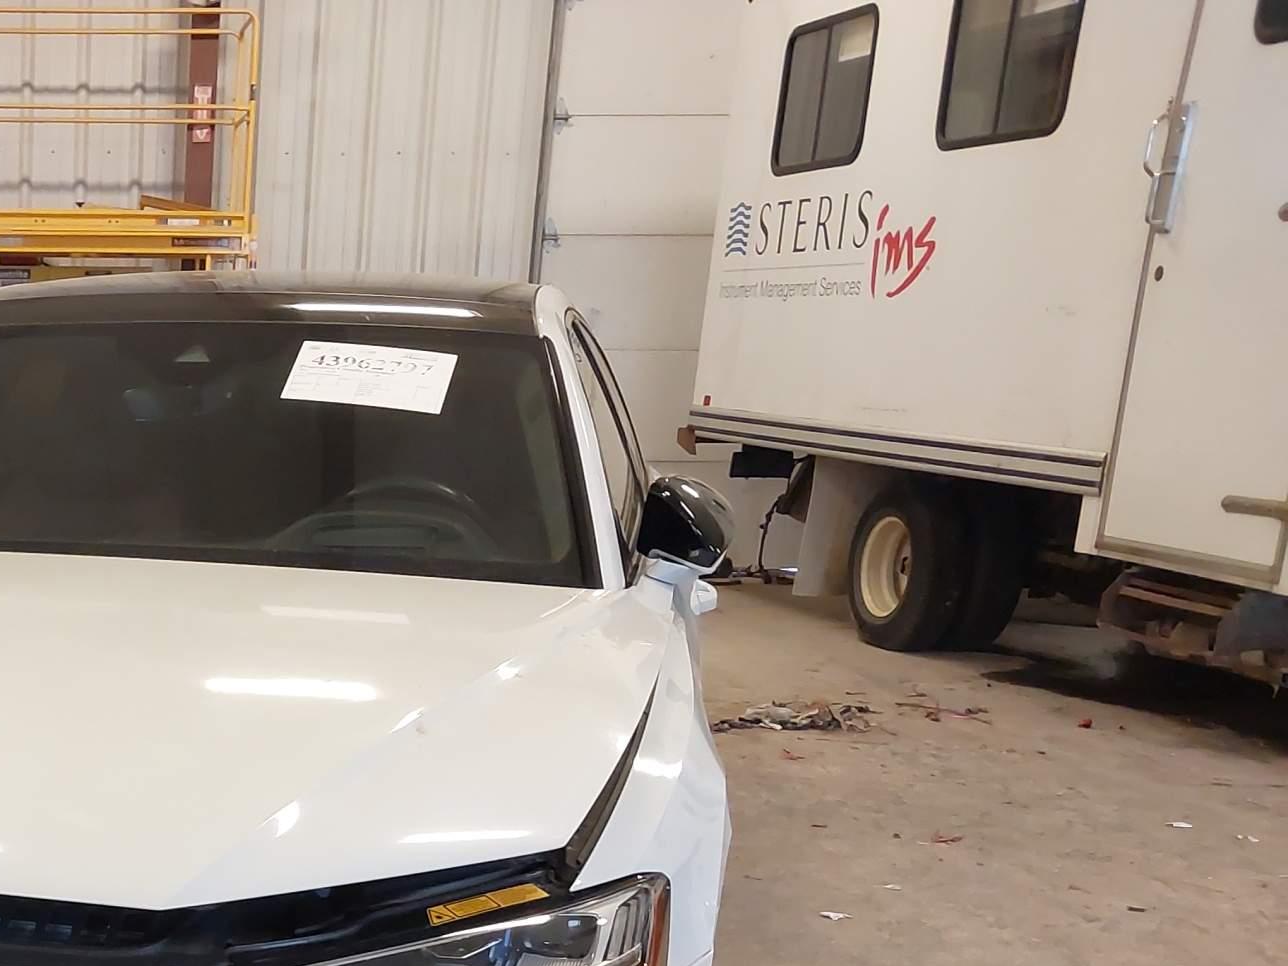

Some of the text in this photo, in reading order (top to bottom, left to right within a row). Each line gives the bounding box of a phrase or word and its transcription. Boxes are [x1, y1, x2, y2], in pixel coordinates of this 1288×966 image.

[755, 189, 873, 256] STERIS
[870, 203, 937, 299] ims
[760, 279, 817, 302] Management
[819, 276, 862, 297] Services
[311, 354, 434, 376] 43962797
